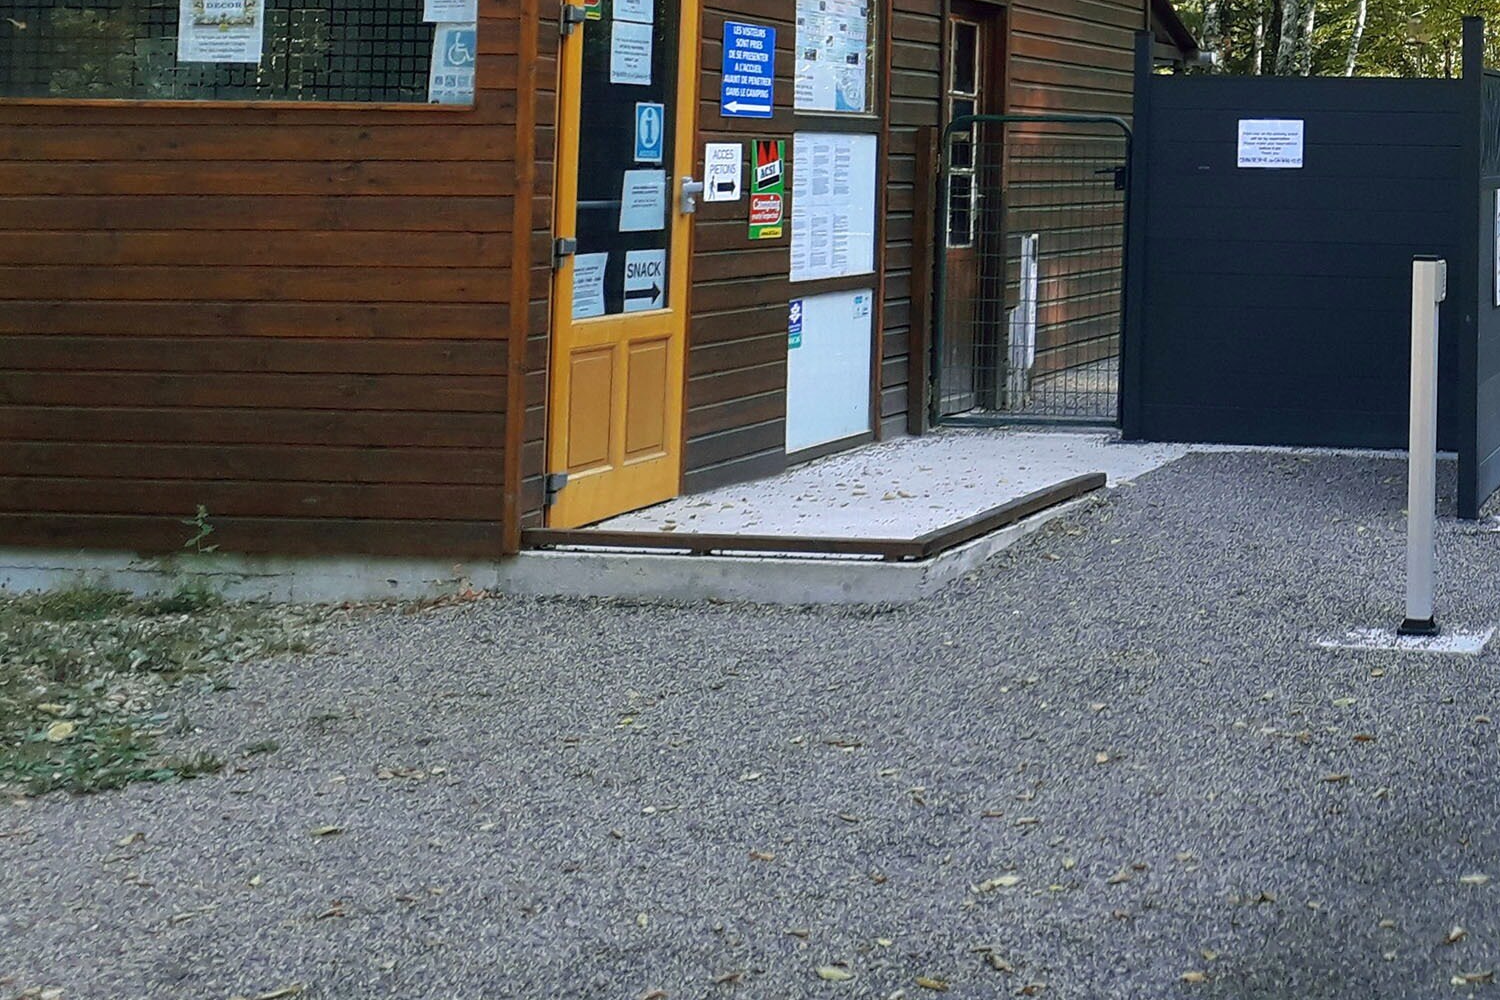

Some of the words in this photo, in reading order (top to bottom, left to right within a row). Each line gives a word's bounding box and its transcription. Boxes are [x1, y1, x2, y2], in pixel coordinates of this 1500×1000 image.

[733, 26, 742, 35] LES
[736, 38, 749, 48] SONT
[724, 74, 740, 84] AVANT
[741, 75, 748, 84] DE
[726, 87, 740, 96] DANS
[740, 88, 746, 97] LE
[746, 88, 768, 98] CAMPING
[713, 149, 734, 160] ACCES
[709, 163, 737, 175] PIETONS
[760, 164, 776, 179] ACSI
[626, 261, 661, 279] SNACK
